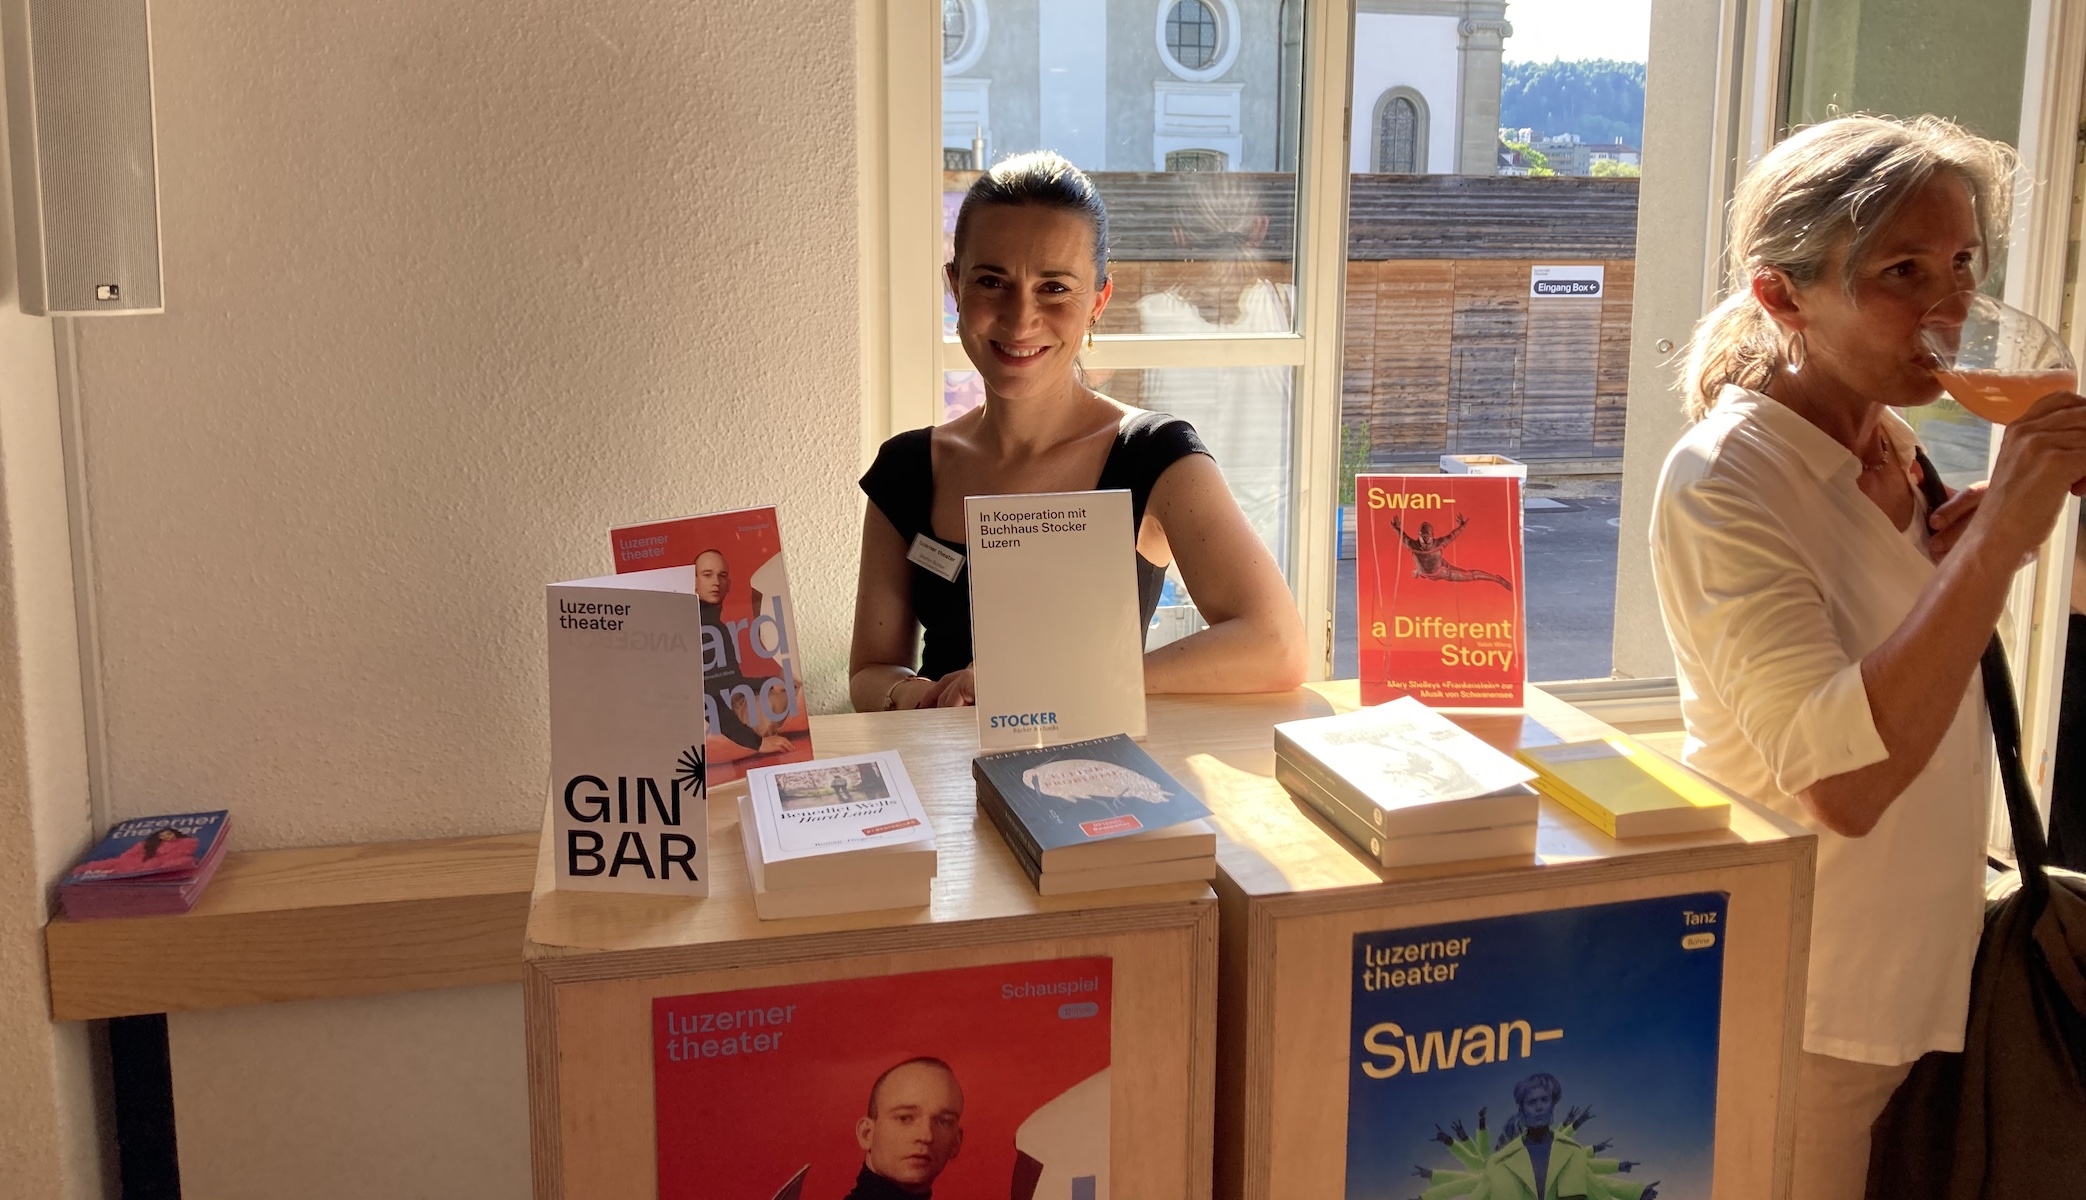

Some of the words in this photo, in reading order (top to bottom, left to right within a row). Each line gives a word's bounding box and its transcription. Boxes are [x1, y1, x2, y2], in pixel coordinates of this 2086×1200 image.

[1538, 283, 1571, 293] Eingang
[1572, 283, 1588, 292] Box
[980, 511, 991, 523] In
[993, 509, 1065, 524] Kooperation
[1067, 508, 1087, 520] mit
[980, 520, 1039, 536] Buchhaus
[1041, 522, 1087, 533] Stocker
[619, 535, 669, 550] luzerner
[981, 538, 1021, 549] Luzern
[620, 546, 665, 561] theater
[559, 598, 631, 616] luzerner
[559, 615, 624, 631] theater
[1372, 621, 1387, 638] a
[1394, 616, 1512, 639] Different
[702, 595, 789, 672] ard
[1441, 643, 1513, 672] Story
[1387, 680, 1407, 690] Mary
[1408, 681, 1441, 690] Shelleys
[704, 658, 799, 739] and
[1420, 690, 1444, 698] Musik
[1460, 691, 1514, 699] Schwanensee
[991, 711, 1058, 728] STOCKER
[985, 752, 1020, 761] NELE
[563, 774, 681, 827] GIN
[781, 806, 851, 820] Benedict
[855, 800, 898, 810] Wells
[798, 813, 839, 824] Hard
[842, 807, 884, 818] Land
[119, 815, 220, 831] luzerner
[567, 828, 699, 882] BAR
[1682, 911, 1718, 926] Tanz
[1364, 935, 1471, 968] luzerner
[1362, 961, 1460, 992] theater
[1001, 976, 1099, 1000] Schauspiel
[667, 1002, 797, 1036] luzerner
[666, 1029, 784, 1063] theater
